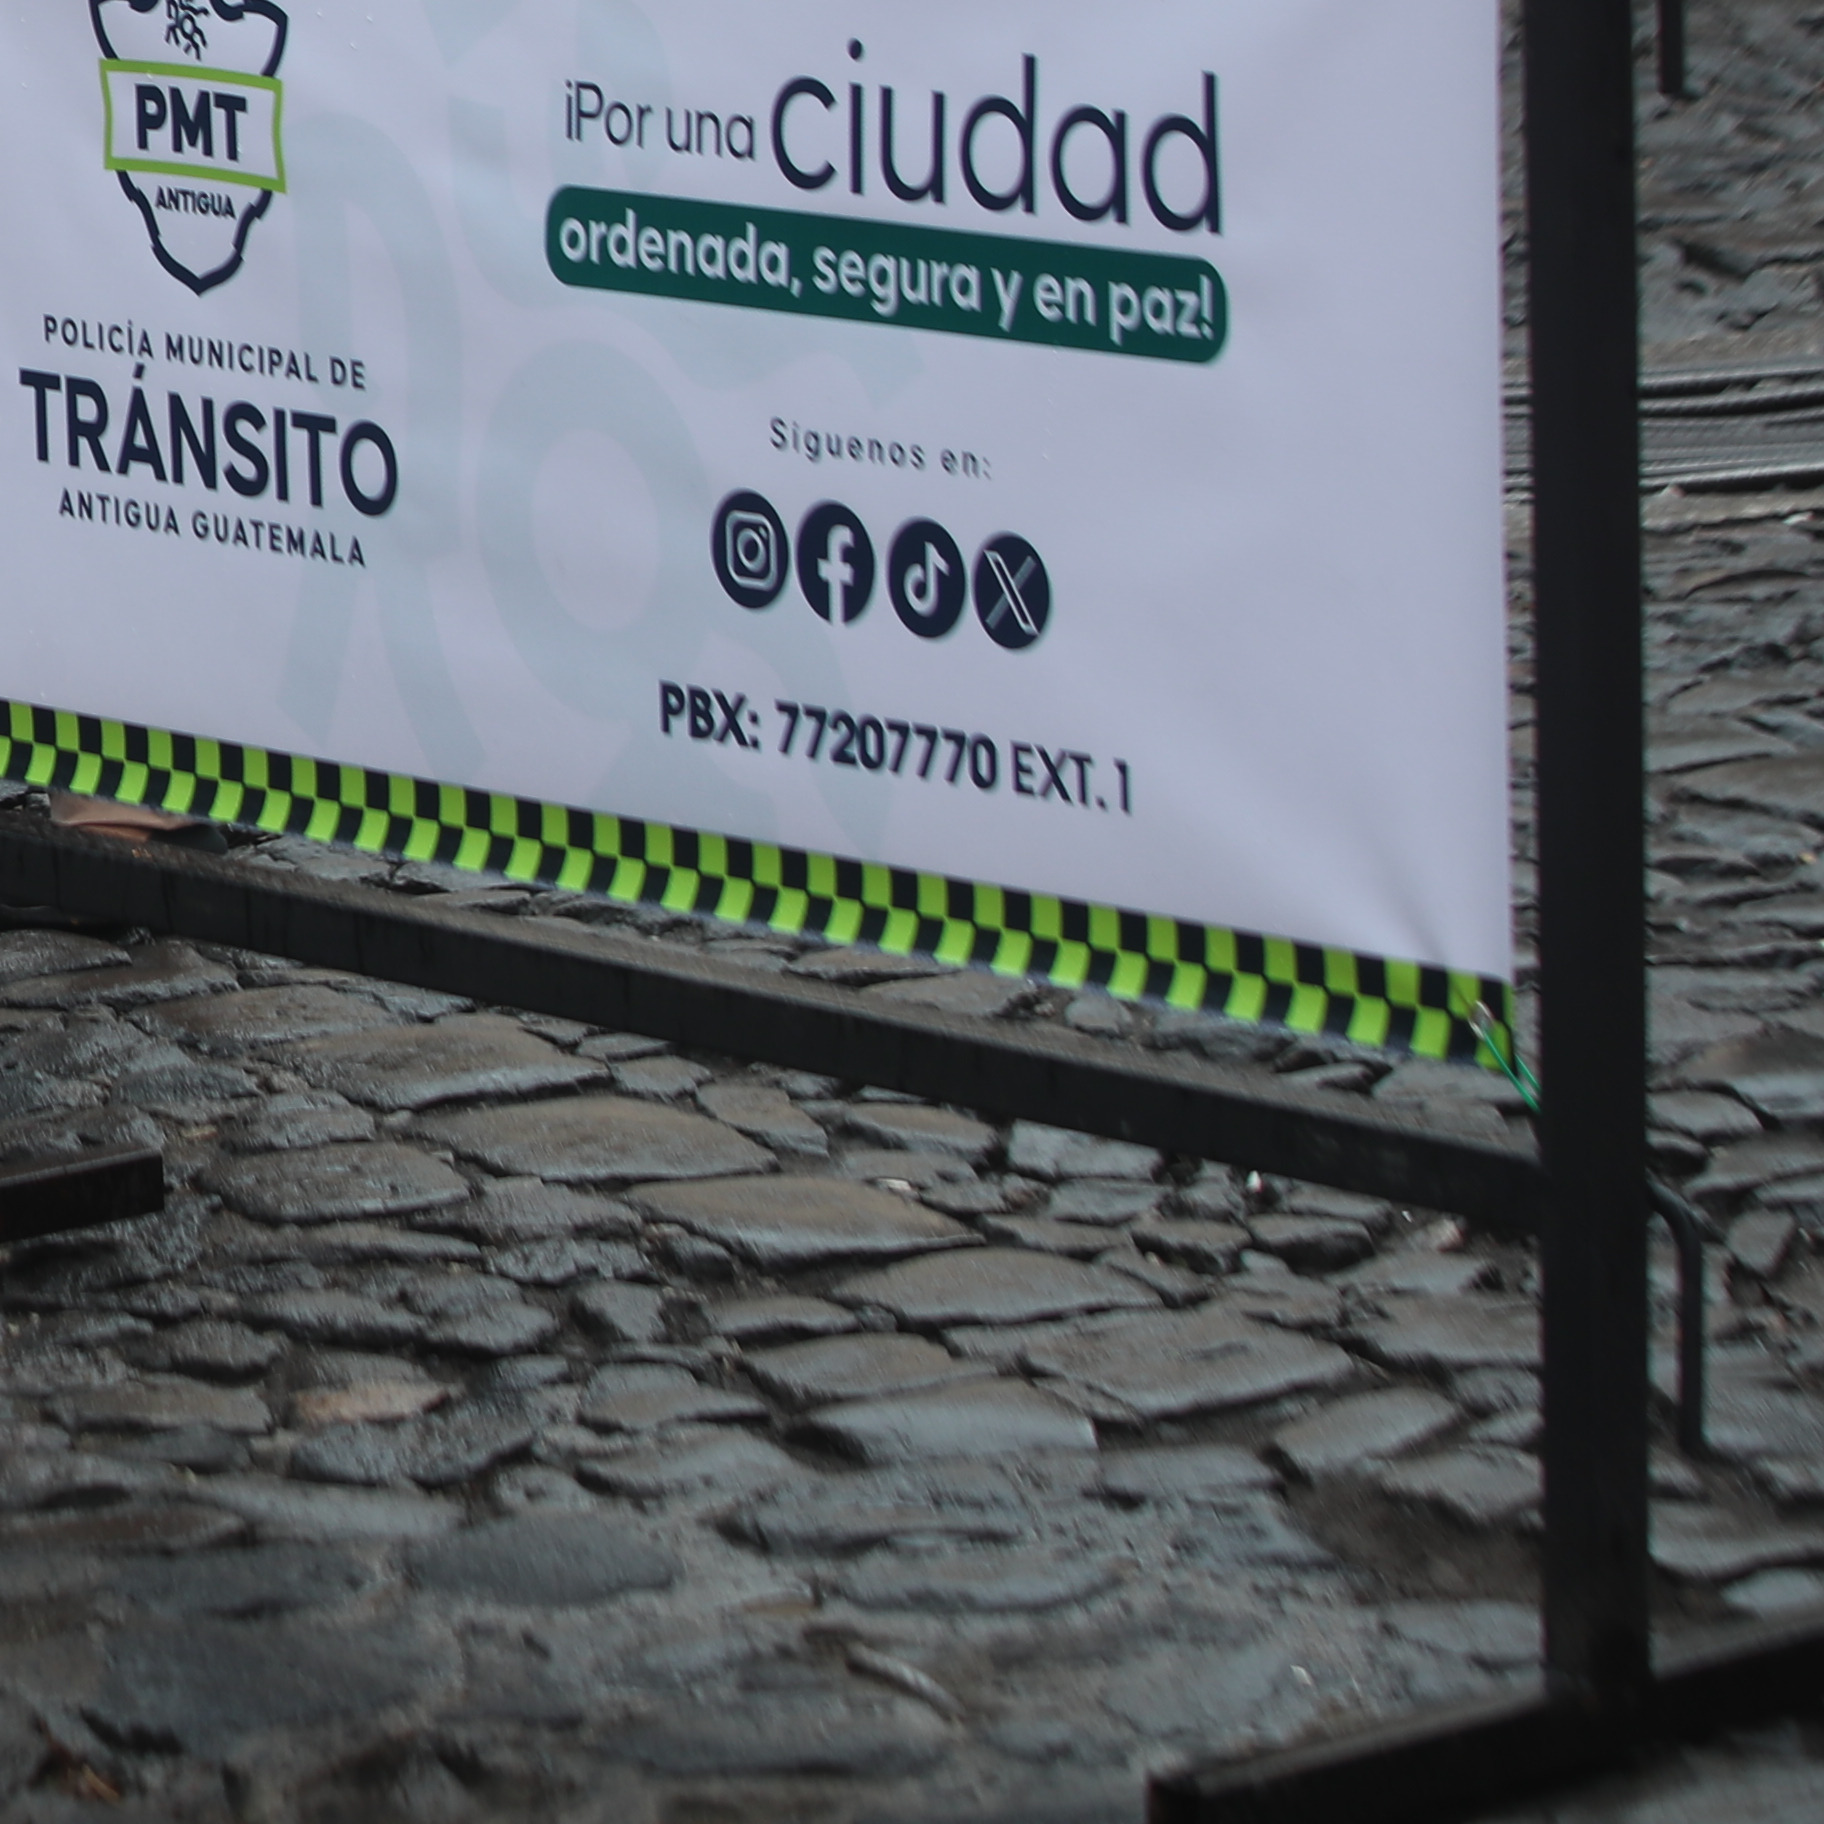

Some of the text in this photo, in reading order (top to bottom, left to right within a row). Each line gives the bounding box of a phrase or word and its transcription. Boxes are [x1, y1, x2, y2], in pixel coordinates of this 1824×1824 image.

[134, 83, 248, 163] PMT
[563, 37, 1223, 236] ¡Por una ciudad
[155, 185, 237, 220] ANTIGUA
[558, 208, 1216, 346] ordenada, segura y en paz!
[42, 314, 366, 391] POLICÍA MUNICIPAL DE
[18, 362, 399, 519] TRÁNSITO
[939, 447, 992, 480] en:
[57, 487, 367, 568] ANTIGUA GUATEMALA
[658, 678, 762, 753] PBX:
[773, 697, 1000, 791] 77207770
